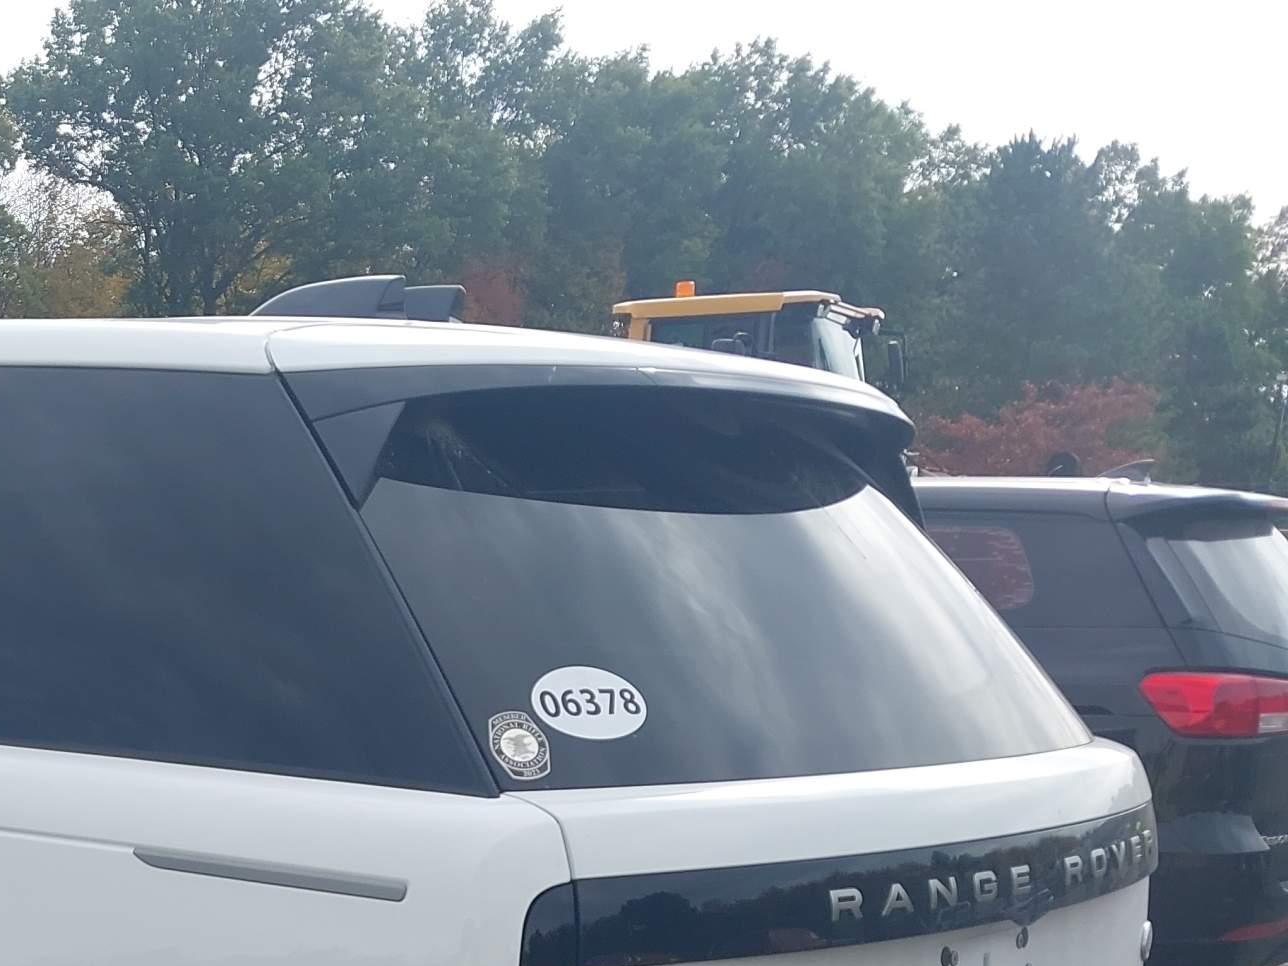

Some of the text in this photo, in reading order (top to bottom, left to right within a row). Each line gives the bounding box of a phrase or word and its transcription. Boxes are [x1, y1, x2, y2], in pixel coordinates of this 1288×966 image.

[539, 688, 641, 718] 06378
[493, 722, 543, 750] NATIONAL RIFLE
[500, 747, 546, 768] ASSOCIATION
[828, 828, 1154, 923] RANGE ROVER
